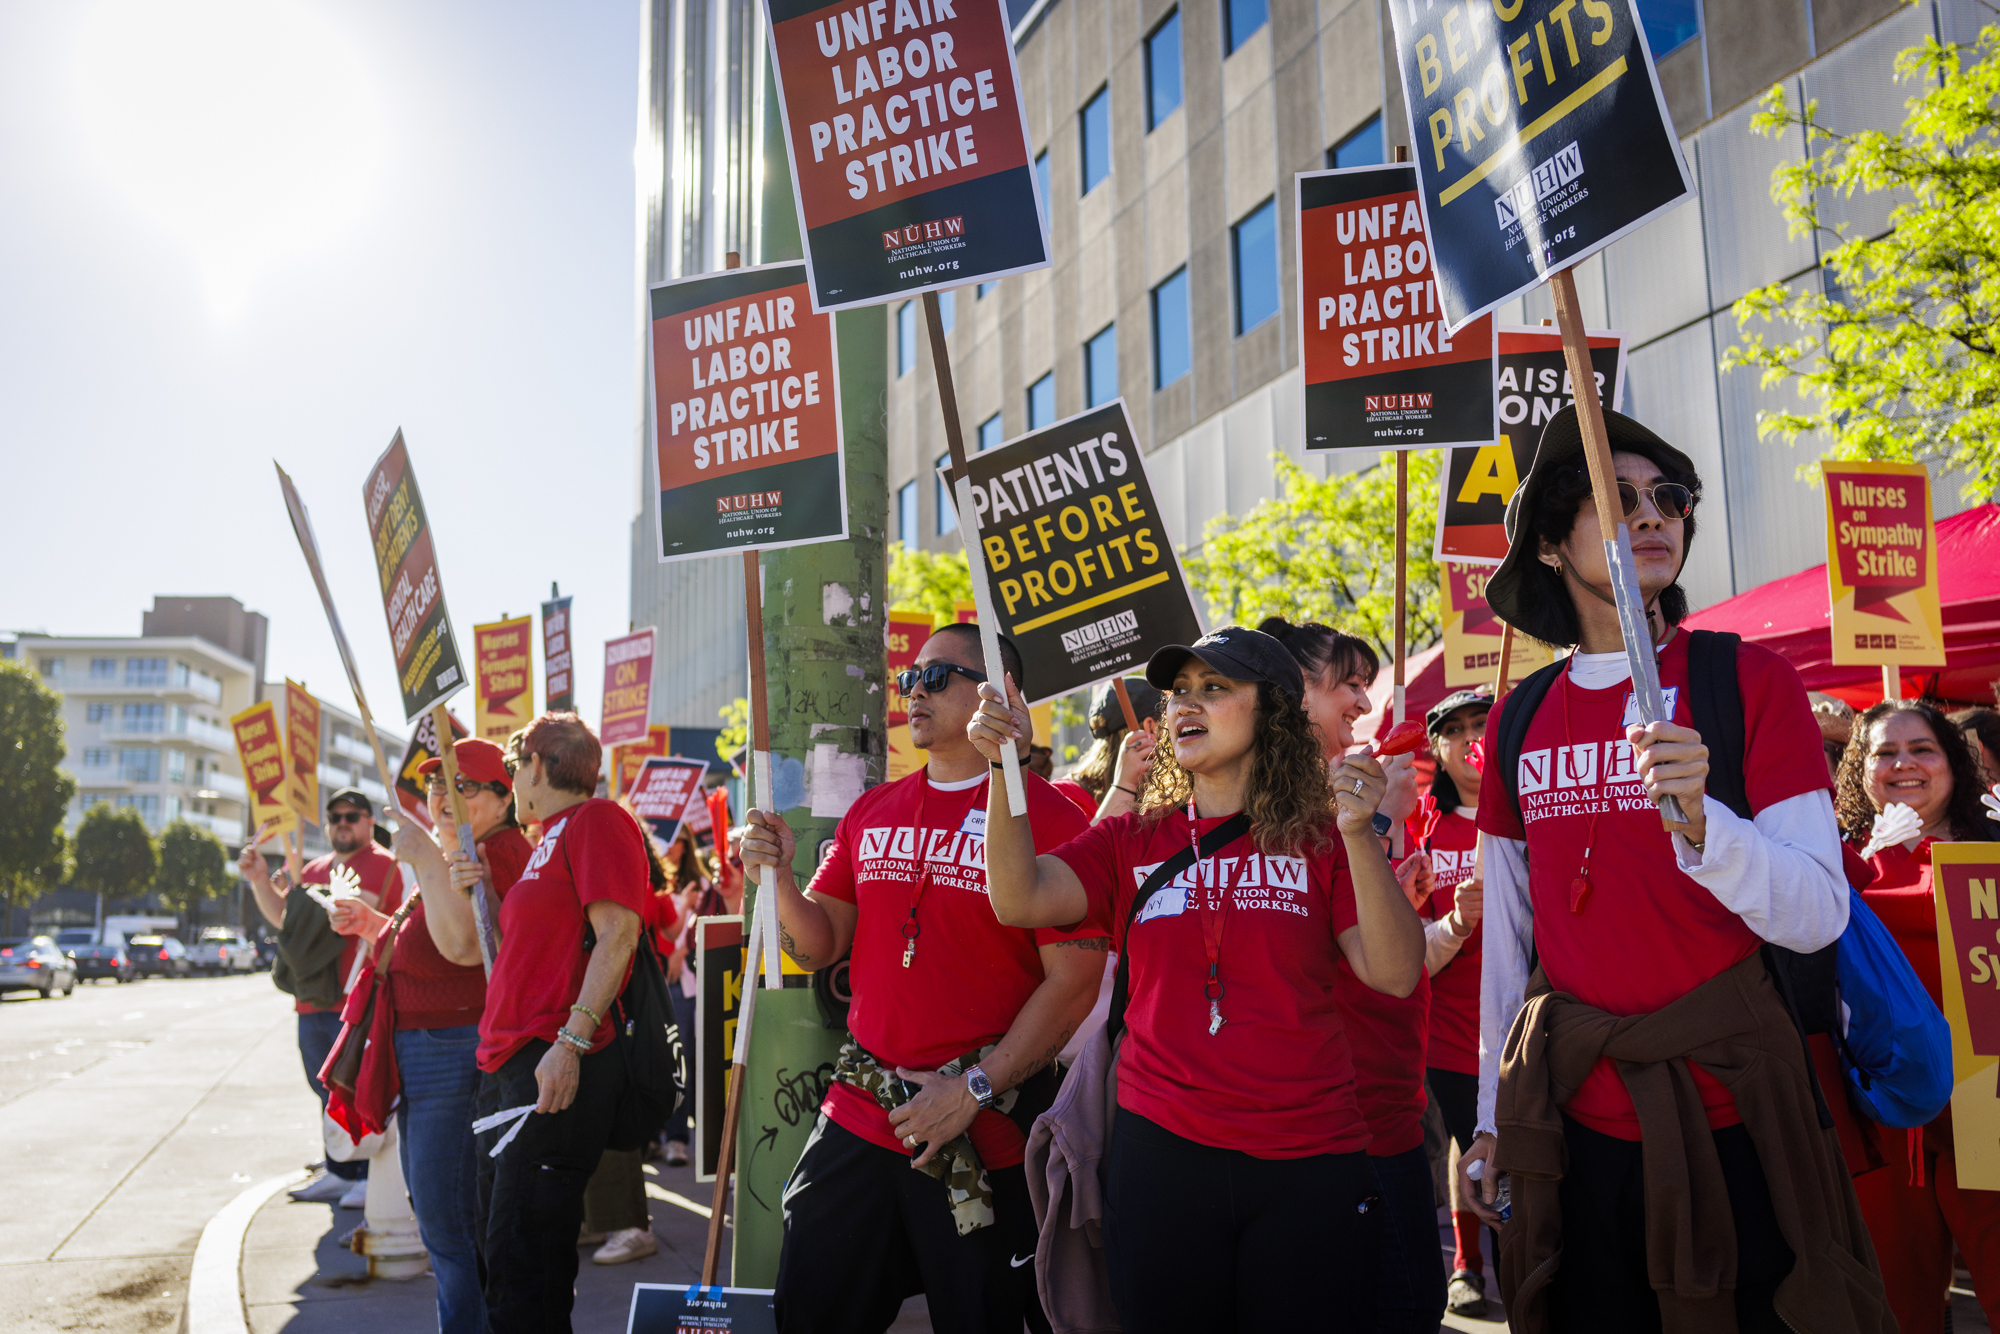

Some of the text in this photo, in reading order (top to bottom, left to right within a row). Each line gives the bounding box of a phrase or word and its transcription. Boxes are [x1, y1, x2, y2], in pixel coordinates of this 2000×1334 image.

[815, 0, 957, 58] UNFAIR
[832, 31, 958, 105] LABOR
[1428, 0, 1614, 172] PROFITS
[809, 69, 998, 163] PRACTICE
[845, 124, 979, 200] STRIKE
[1495, 142, 1582, 228] NUHW
[1336, 200, 1422, 245] UNFA
[1504, 188, 1589, 251] HEALTHCARE WORKERS
[1507, 181, 1579, 238] NATIONAL UNION OF
[883, 216, 964, 249] NUHW
[891, 244, 926, 256] NATIONAL
[927, 238, 950, 248] UNION
[1526, 226, 1576, 264] nuhw.org
[887, 242, 966, 264] HEALTHCARE WORKERS
[1344, 240, 1433, 286] LABO
[900, 260, 960, 280] nuhw.org
[1319, 278, 1436, 331] PRACTI
[684, 296, 796, 351] UNFAIR
[1342, 319, 1453, 367] STRIKE
[692, 337, 792, 390] LABOR
[671, 370, 820, 437] PRACTICE
[1365, 393, 1432, 411] NUHW
[693, 416, 800, 470] STRIKE
[1374, 428, 1424, 437] nuhw.org
[971, 432, 1127, 530] PATIENTS
[1840, 481, 1907, 509] Nurses
[717, 491, 782, 512] NUHW
[722, 510, 749, 518] NATIONAL
[1853, 510, 1867, 522] on
[719, 515, 754, 524] HEALTHCARE
[727, 527, 775, 538] nuhw.org
[982, 482, 1146, 572] BEFORE
[1840, 521, 1923, 550] Sympathy
[999, 528, 1159, 616] PROFITS
[1856, 550, 1917, 577] Strike
[388, 570, 413, 630] MENTAL
[394, 599, 418, 658] HEALTH
[415, 566, 437, 615] CARE
[481, 632, 519, 652] Nurses
[1062, 610, 1137, 651] NUHW
[1073, 642, 1104, 656] NATIONAL
[1104, 634, 1125, 644] UNION
[1071, 634, 1141, 664] HEALTHCARE WORKERS
[1090, 653, 1131, 672] nuhw.org
[480, 654, 527, 674] Sympathy
[615, 661, 638, 686] ON
[489, 672, 523, 693] Strike
[604, 682, 648, 714] STRIKE
[650, 768, 692, 781] UNFAIR
[1519, 741, 1642, 793] NUH
[631, 792, 688, 805] PRACTICE
[646, 780, 684, 792] LABOR
[1527, 788, 1599, 808] NATIONAL
[1523, 801, 1610, 824] HEALTHCARE
[857, 871, 988, 894] HEALTHCAR WORKERS
[963, 869, 979, 880] OF
[1235, 899, 1308, 917] WORKERS
[1276, 891, 1295, 901] OF
